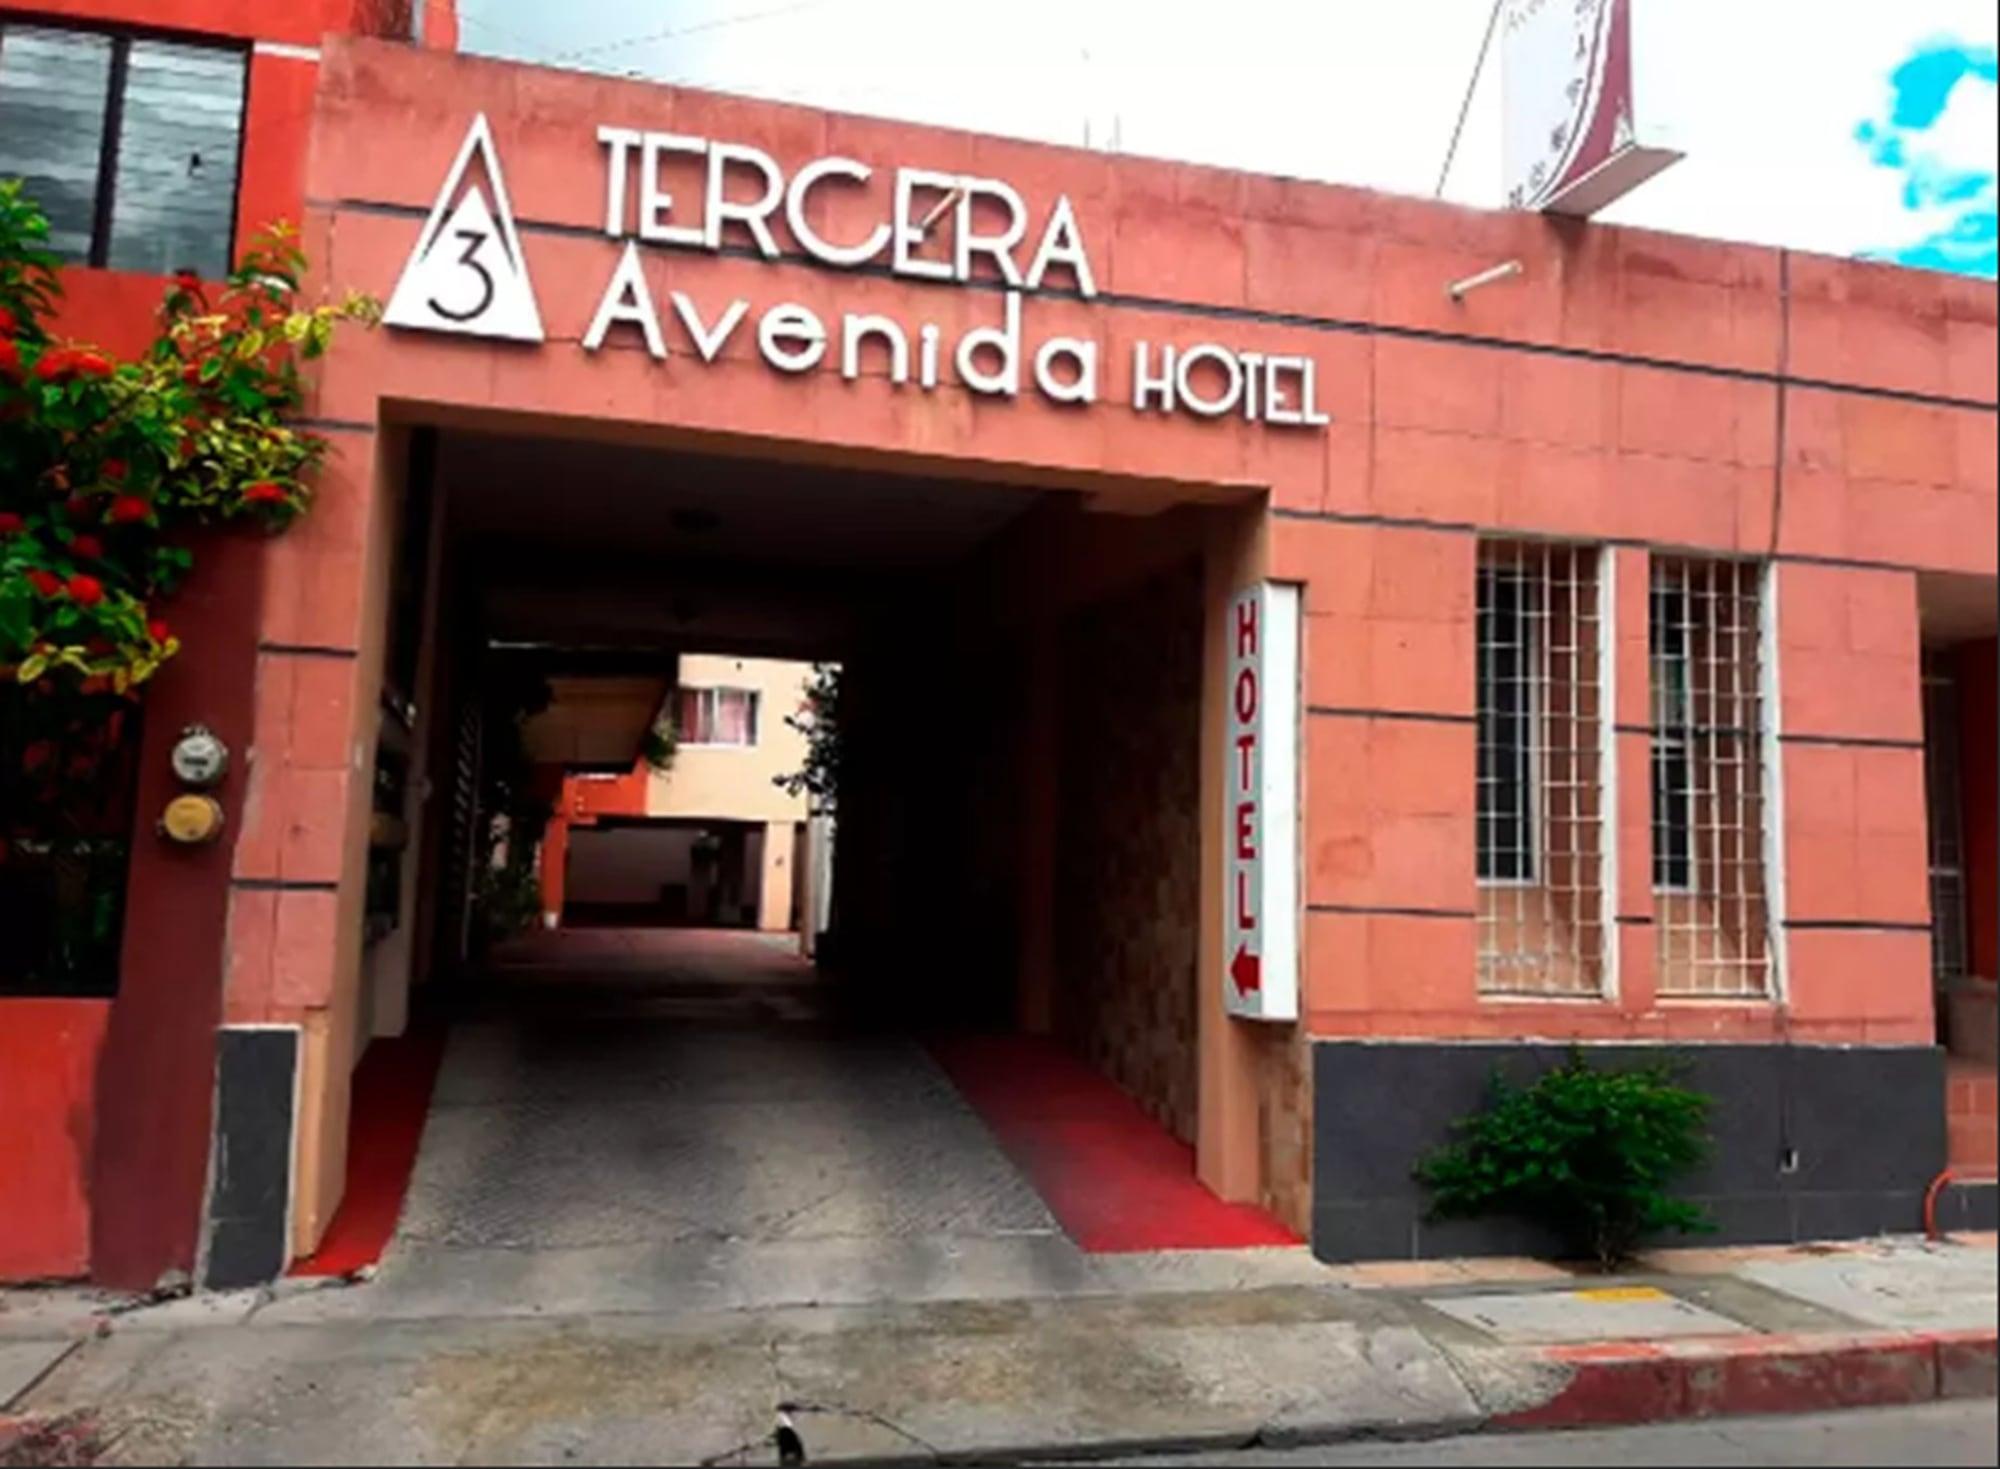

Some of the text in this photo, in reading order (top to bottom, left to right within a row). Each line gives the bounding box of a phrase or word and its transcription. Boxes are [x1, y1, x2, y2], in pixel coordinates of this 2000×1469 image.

[427, 230, 494, 321] 3
[597, 126, 1096, 297] TERCERA
[582, 239, 1331, 424] Avenida HOTEL
[1235, 599, 1257, 930] HOTEL
